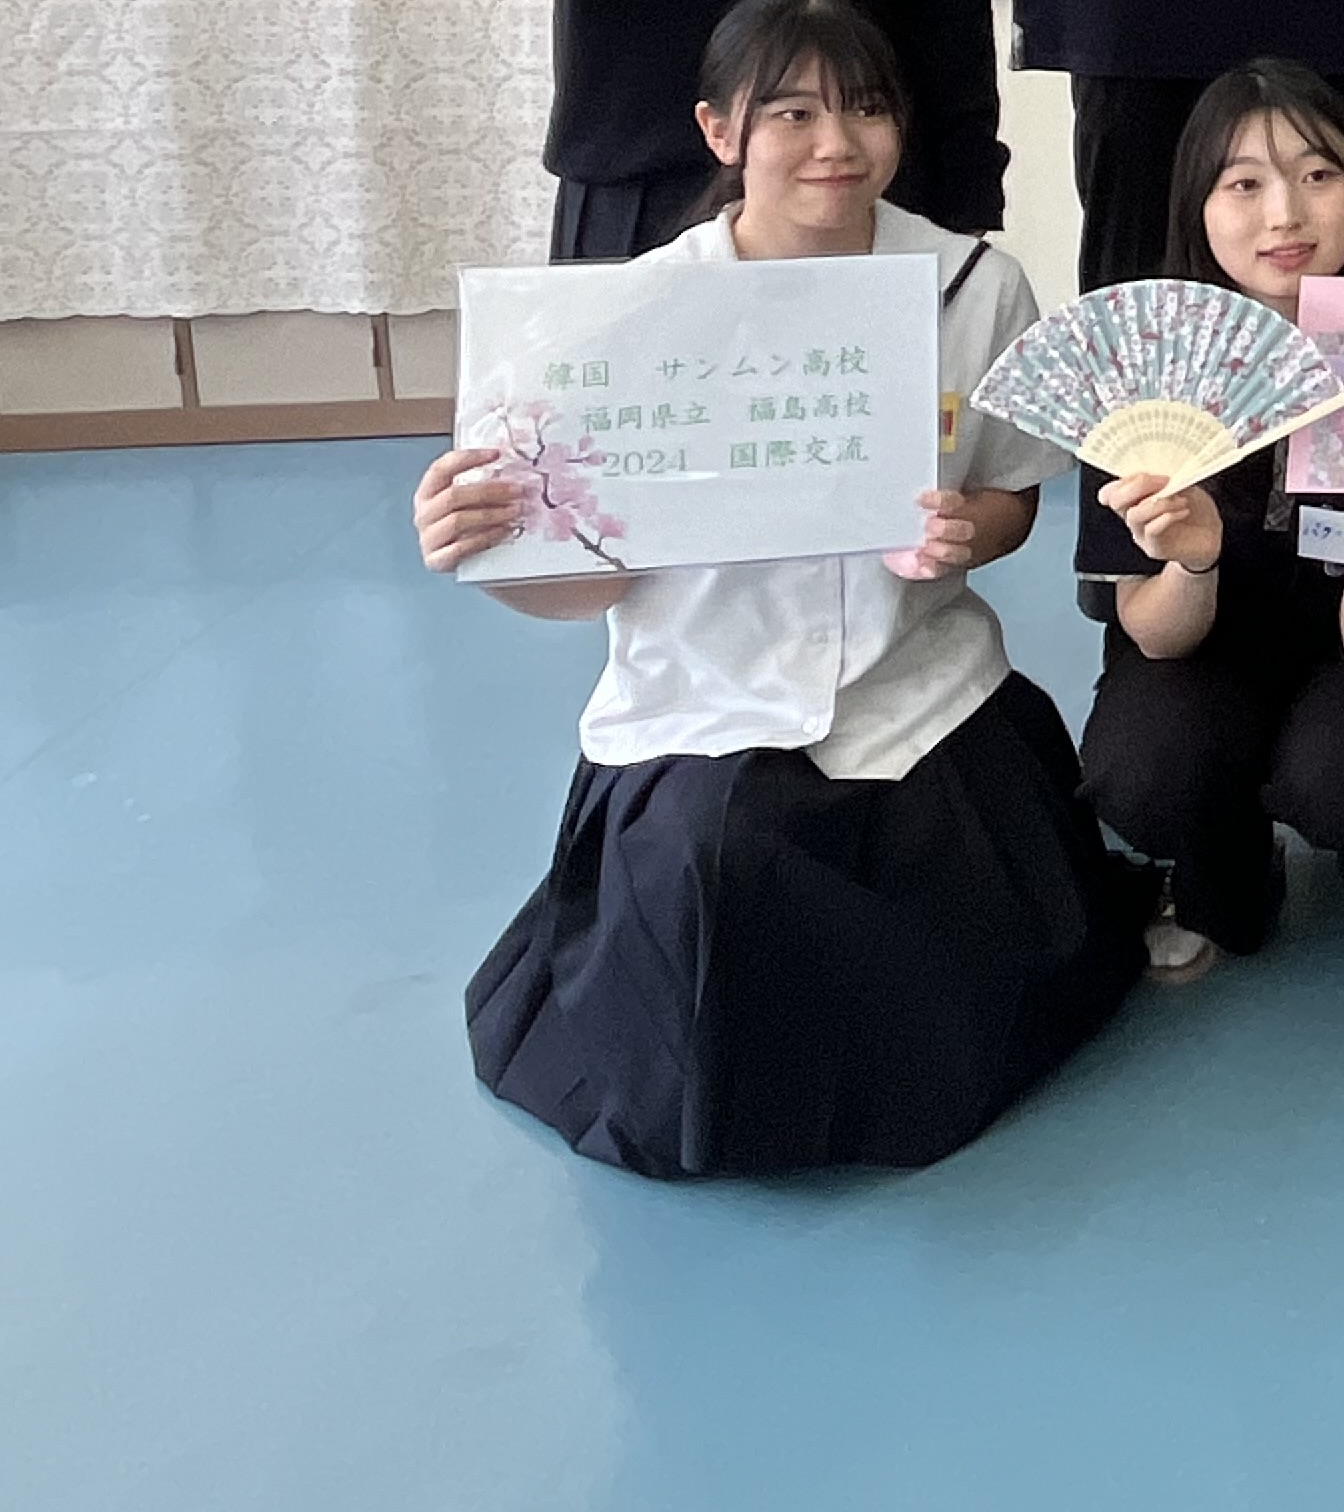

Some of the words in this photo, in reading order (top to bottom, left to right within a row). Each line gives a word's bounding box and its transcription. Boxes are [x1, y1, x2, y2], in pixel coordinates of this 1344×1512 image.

[543, 360, 610, 389] 韓国
[654, 345, 869, 381] サンムン高校
[580, 401, 712, 433] 福岡県立
[749, 391, 872, 422] 福島高校
[602, 448, 687, 477] 2024
[730, 435, 870, 469] 国際交流
